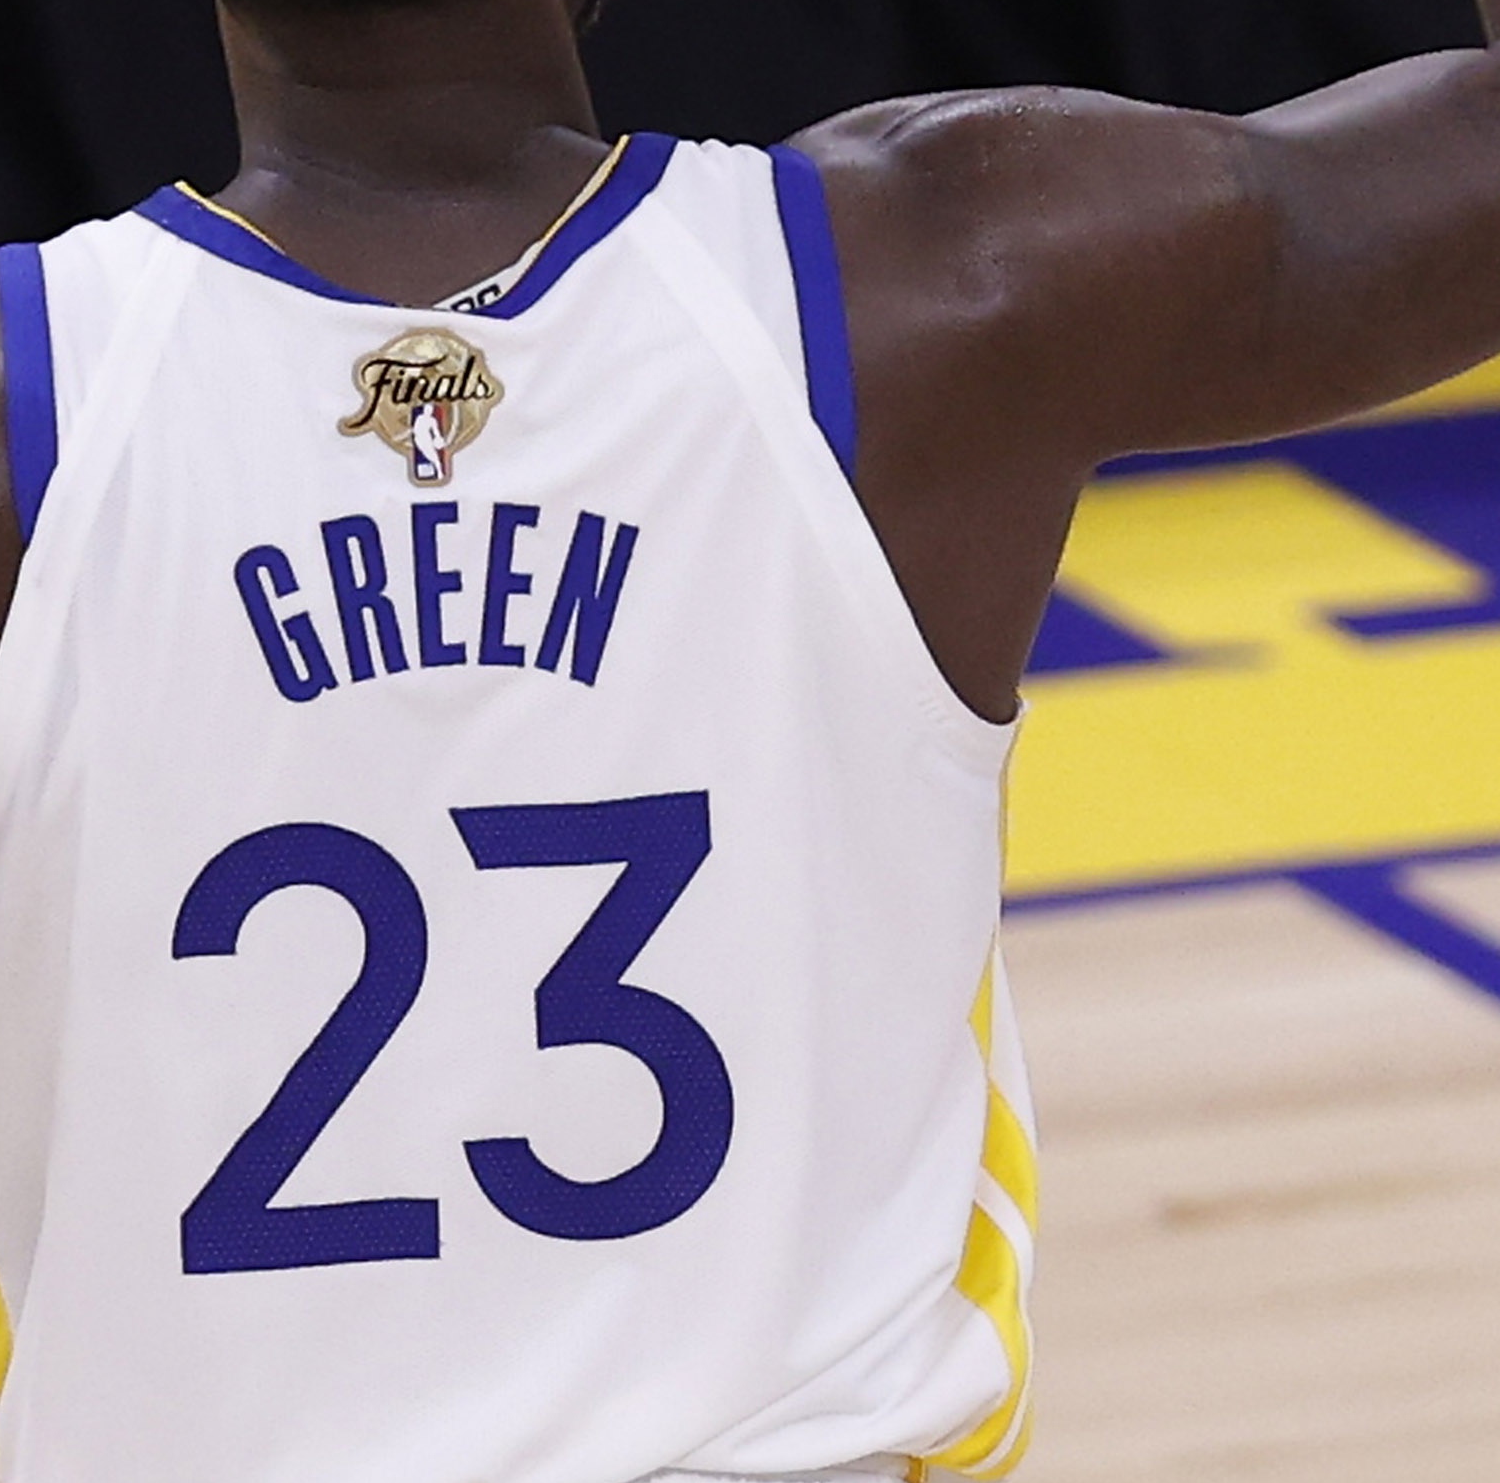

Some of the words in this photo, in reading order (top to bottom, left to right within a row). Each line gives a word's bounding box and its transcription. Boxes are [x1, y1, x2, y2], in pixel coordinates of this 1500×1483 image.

[345, 355, 495, 429] Finals
[232, 501, 640, 704] GREEN
[170, 787, 736, 1276] 23
